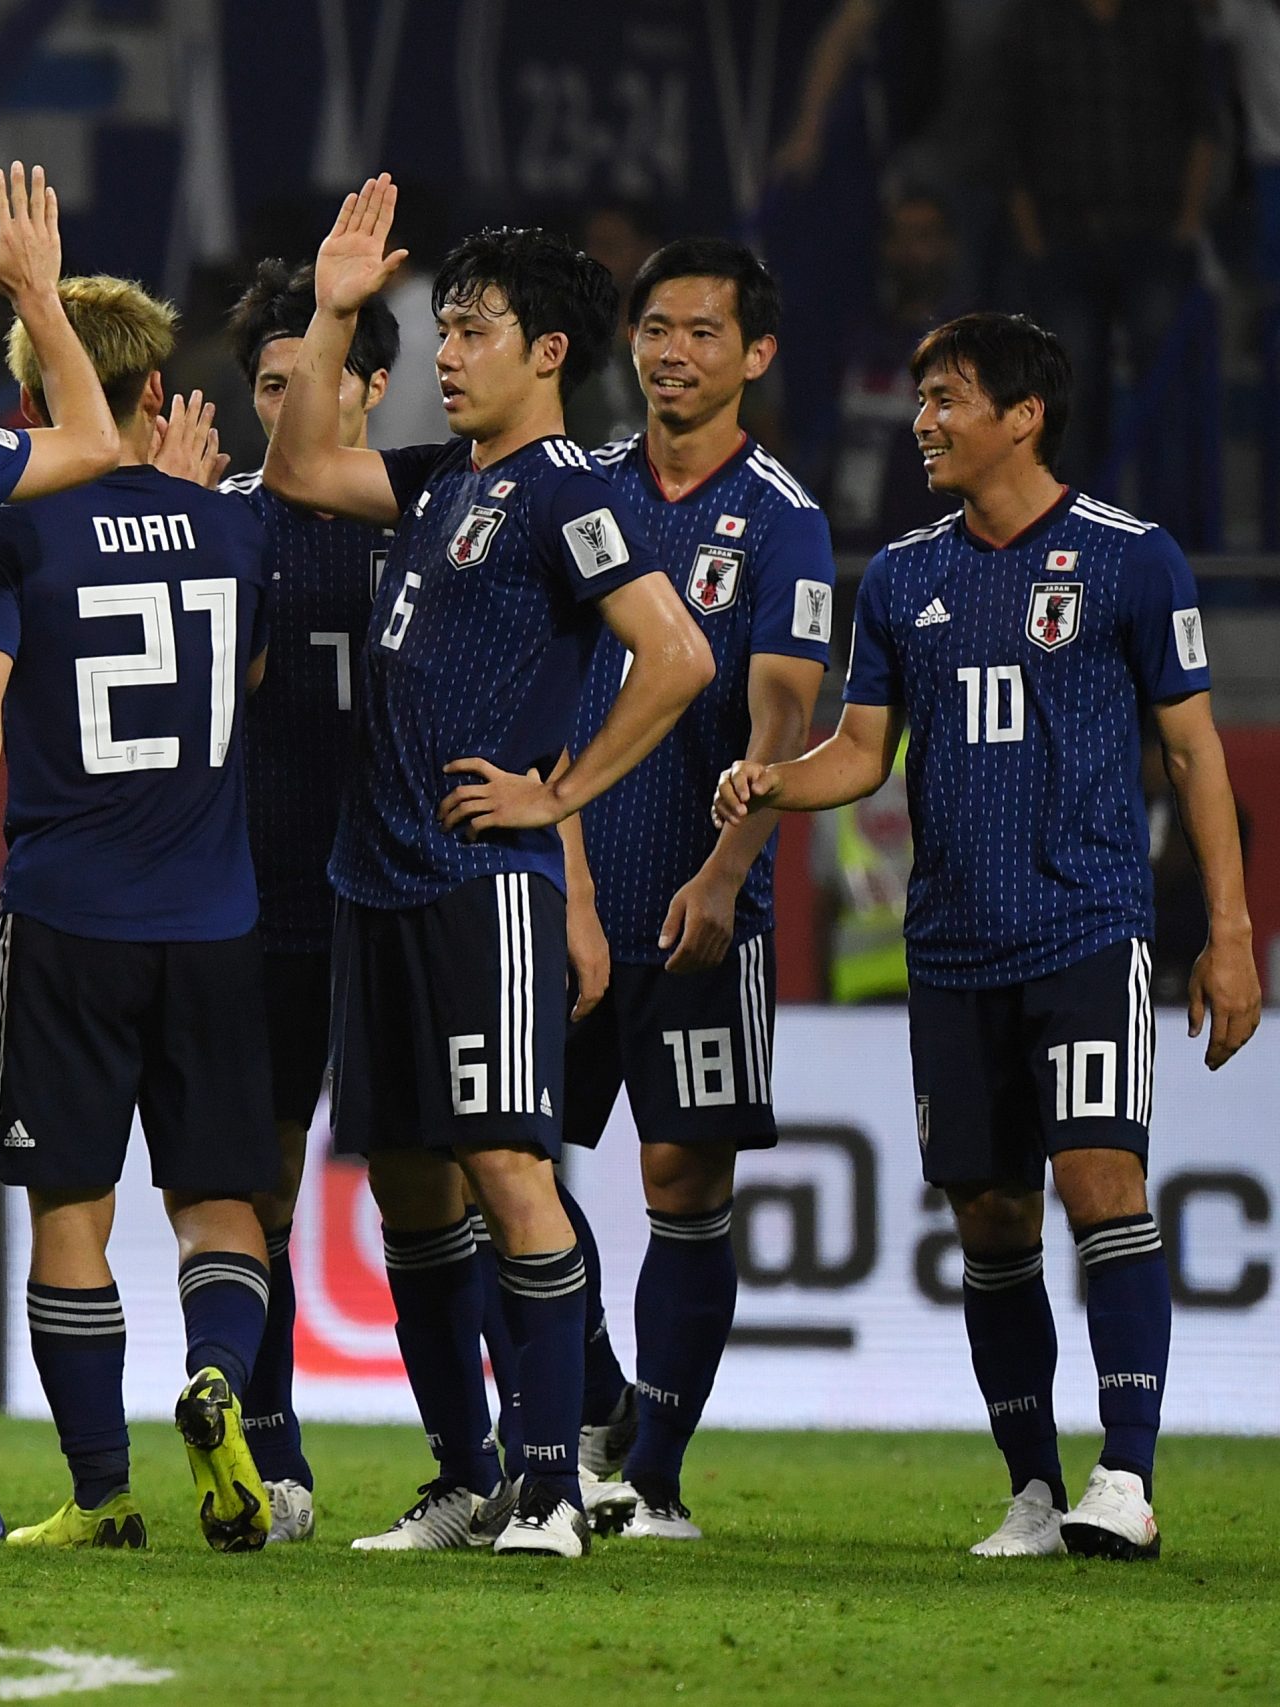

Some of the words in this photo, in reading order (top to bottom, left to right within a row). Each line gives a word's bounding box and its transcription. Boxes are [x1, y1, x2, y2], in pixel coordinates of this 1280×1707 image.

[92, 513, 197, 553] DOAN
[707, 548, 733, 558] JAPAN
[380, 570, 422, 651] 6
[914, 612, 952, 628] adidas
[956, 664, 1025, 745] 10
[448, 1033, 489, 1116] 6
[662, 1026, 737, 1108] 18
[1047, 1040, 1118, 1121] 10
[3, 1137, 36, 1148] adidas
[1098, 1373, 1158, 1392] JAPAN
